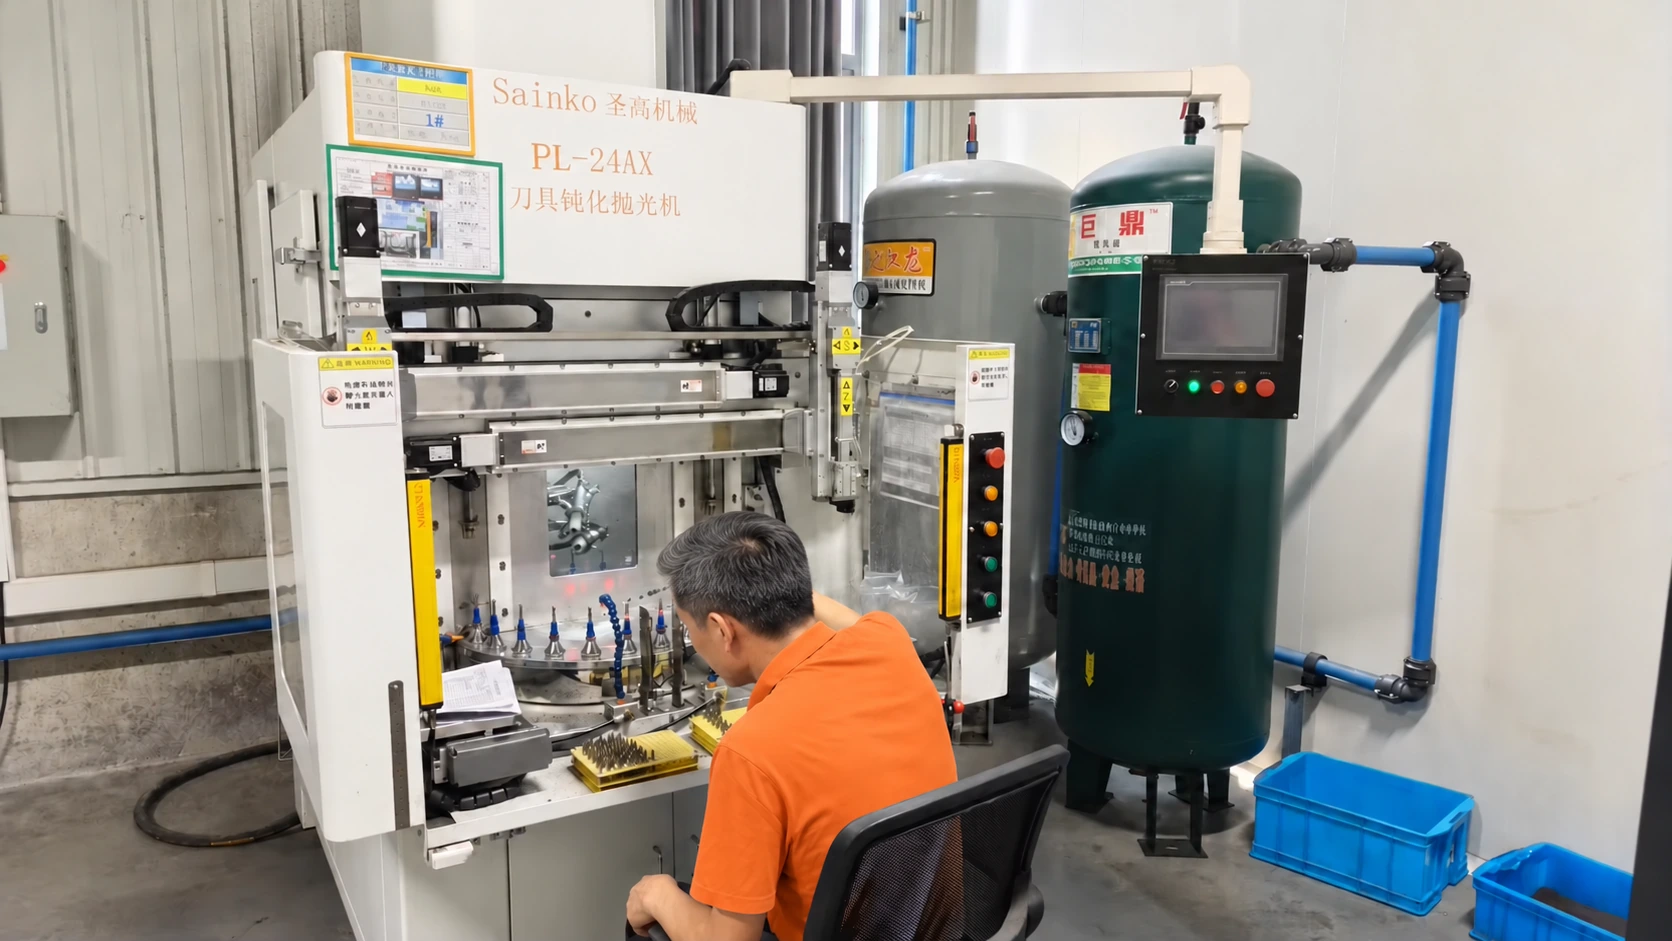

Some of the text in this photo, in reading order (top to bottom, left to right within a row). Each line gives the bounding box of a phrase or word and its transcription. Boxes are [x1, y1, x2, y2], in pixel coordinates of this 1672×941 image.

[493, 77, 698, 125] Sainko 圣高机械
[426, 113, 444, 128] 1#
[531, 142, 654, 176] PL-24AX
[509, 186, 681, 217] 刀具钝化抛光机
[1081, 210, 1144, 239] 巨鼎
